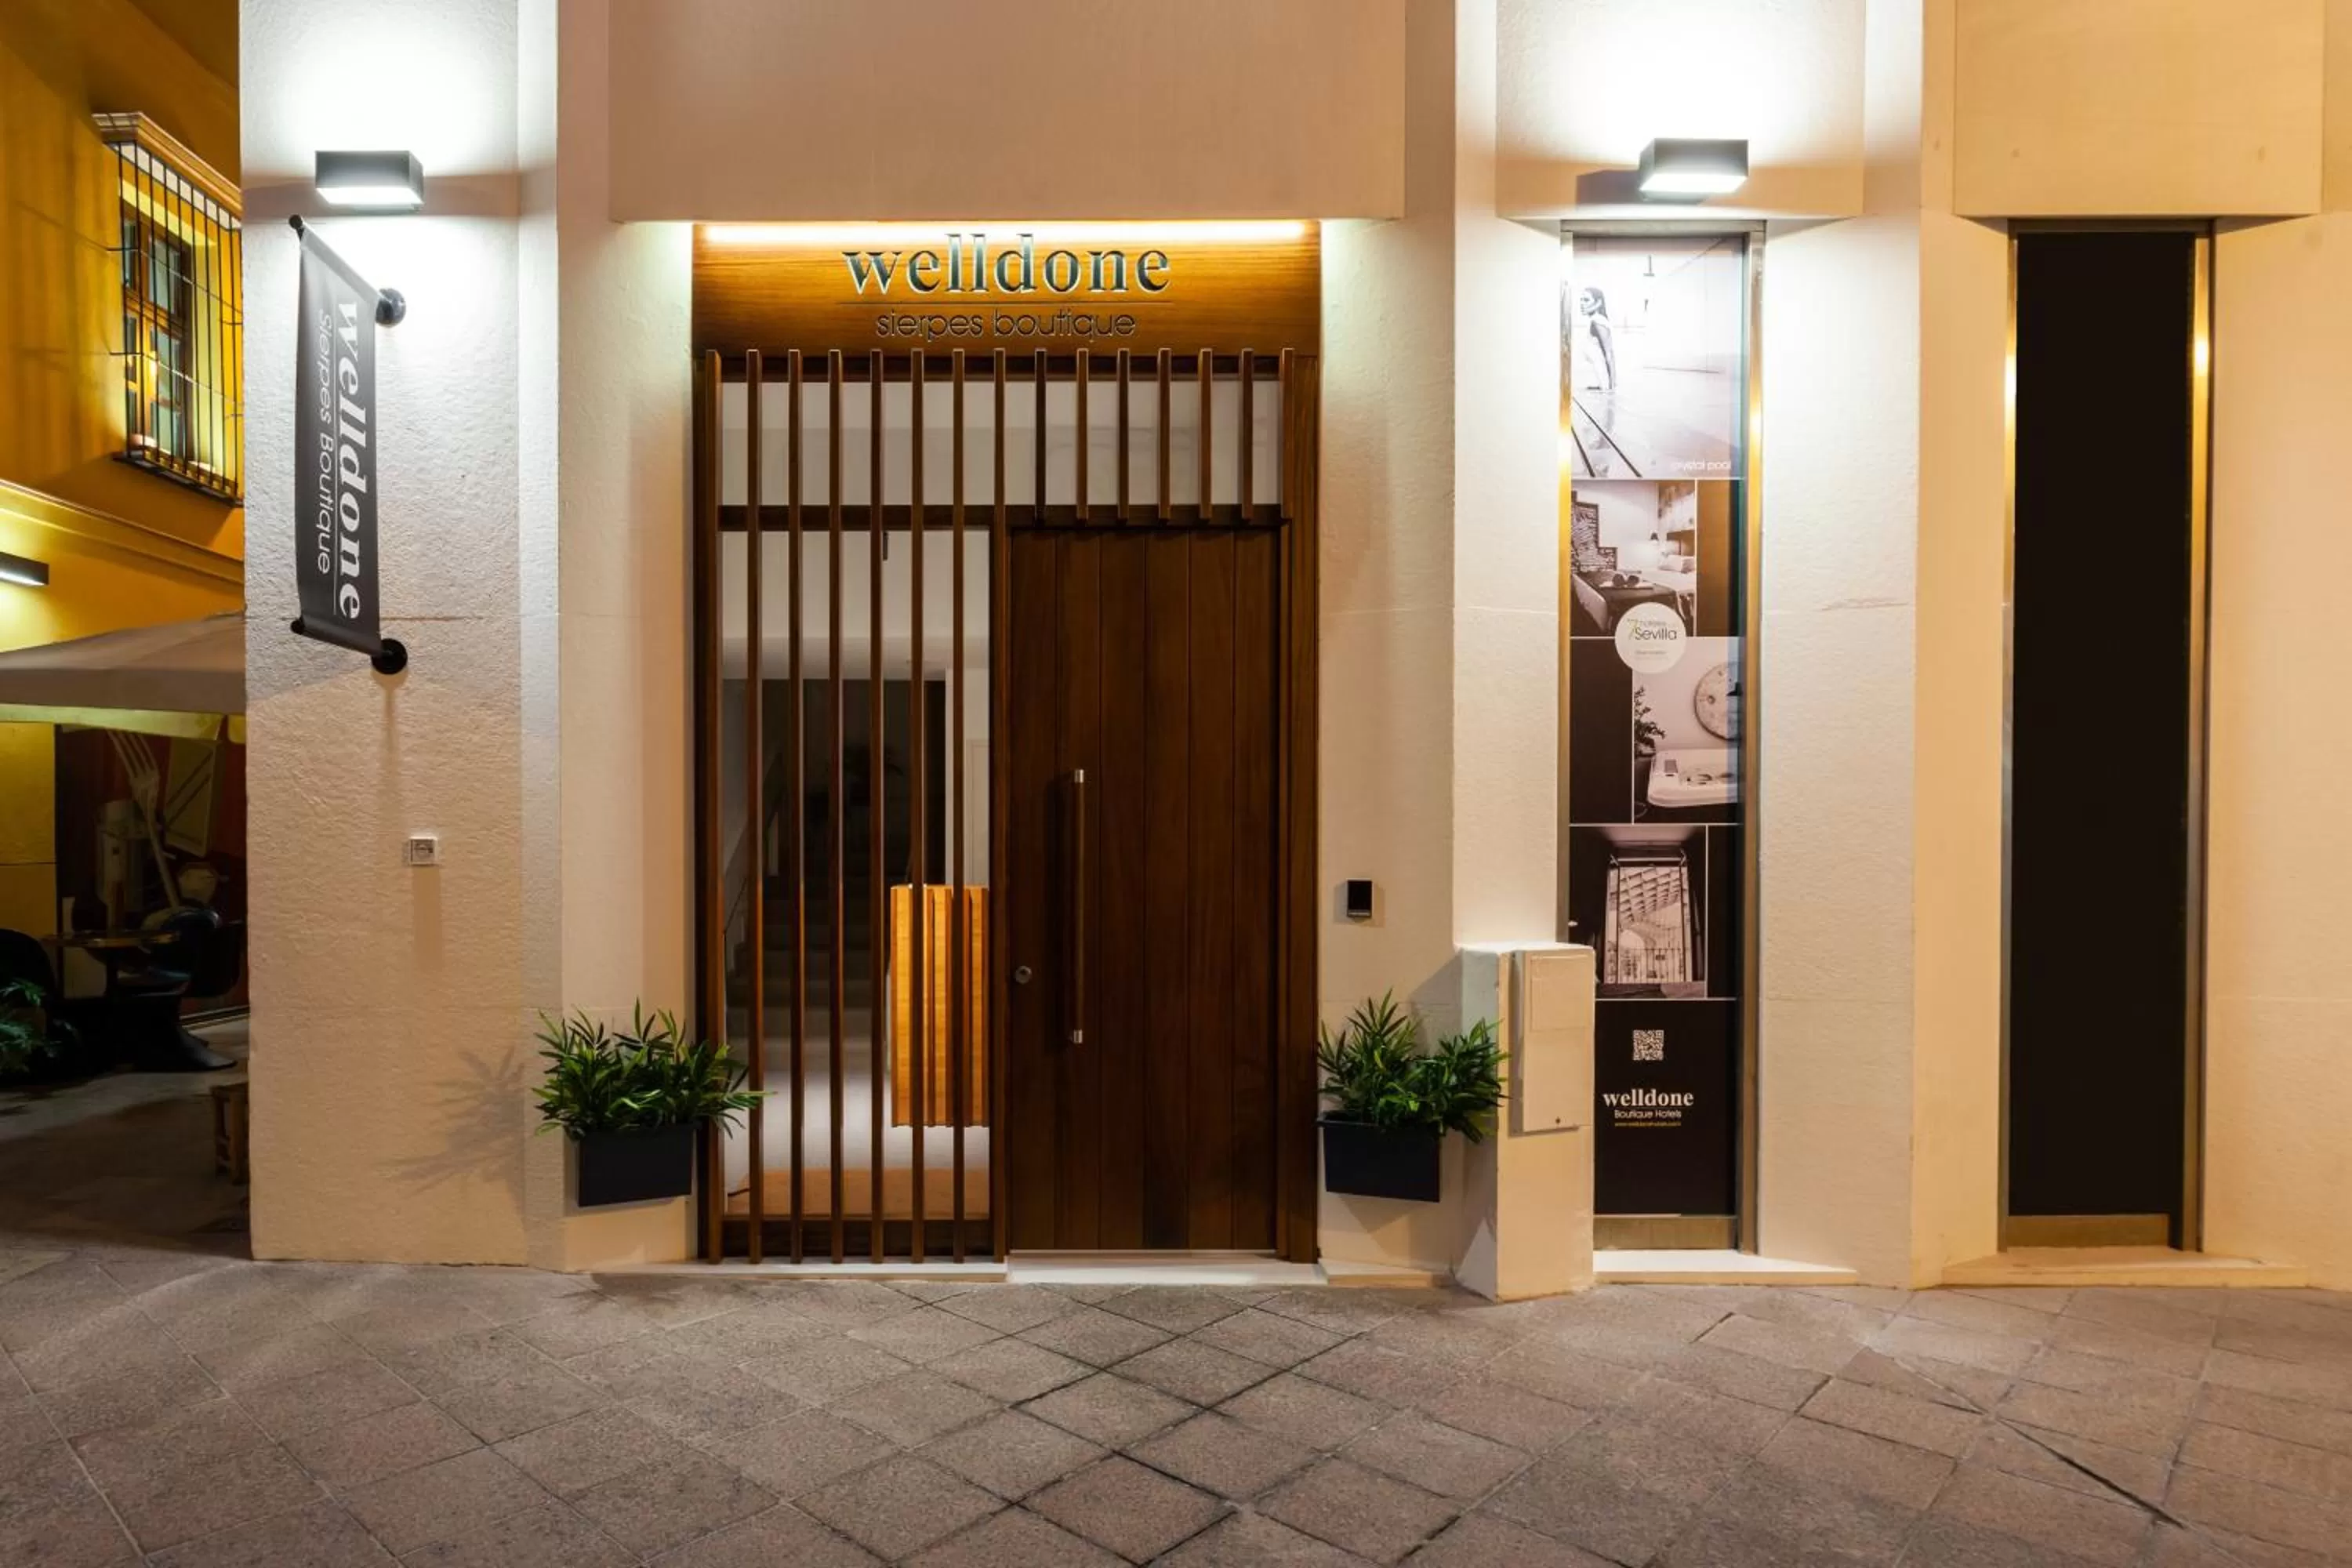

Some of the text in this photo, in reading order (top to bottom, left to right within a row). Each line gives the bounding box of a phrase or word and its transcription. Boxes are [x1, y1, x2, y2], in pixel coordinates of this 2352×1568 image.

[841, 233, 1171, 295] welldone
[876, 307, 1137, 343] sierpes boutique
[317, 310, 335, 575] Sierpes Boutique
[337, 301, 367, 619] welldone
[1635, 627, 1678, 641] Sevilla
[1602, 1088, 1694, 1107] welldone
[1614, 1109, 1653, 1120] Boutique
